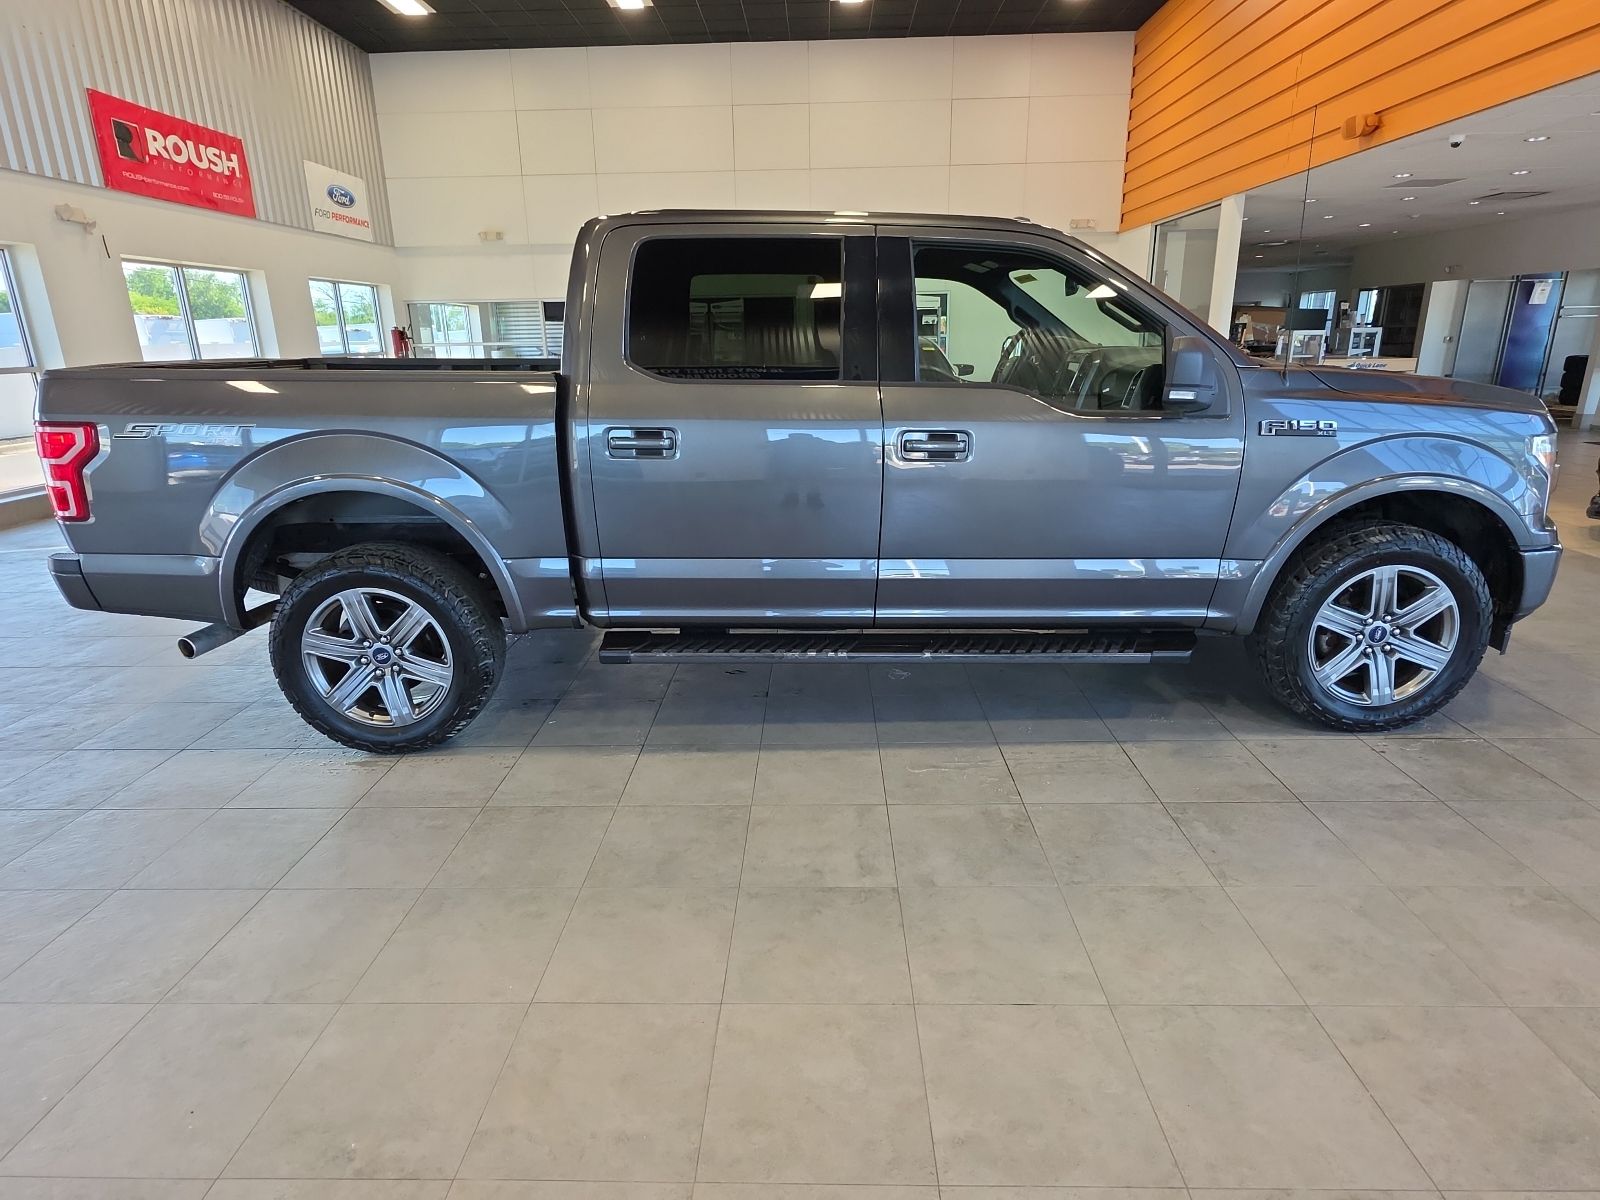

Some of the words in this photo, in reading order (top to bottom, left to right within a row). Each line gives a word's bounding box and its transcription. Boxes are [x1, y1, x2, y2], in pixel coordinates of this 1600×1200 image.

[144, 127, 241, 178] ROUSH
[332, 187, 351, 206] Ford
[314, 207, 331, 219] FORD
[331, 211, 370, 229] PERFORMANCE
[113, 422, 257, 440] SPORT
